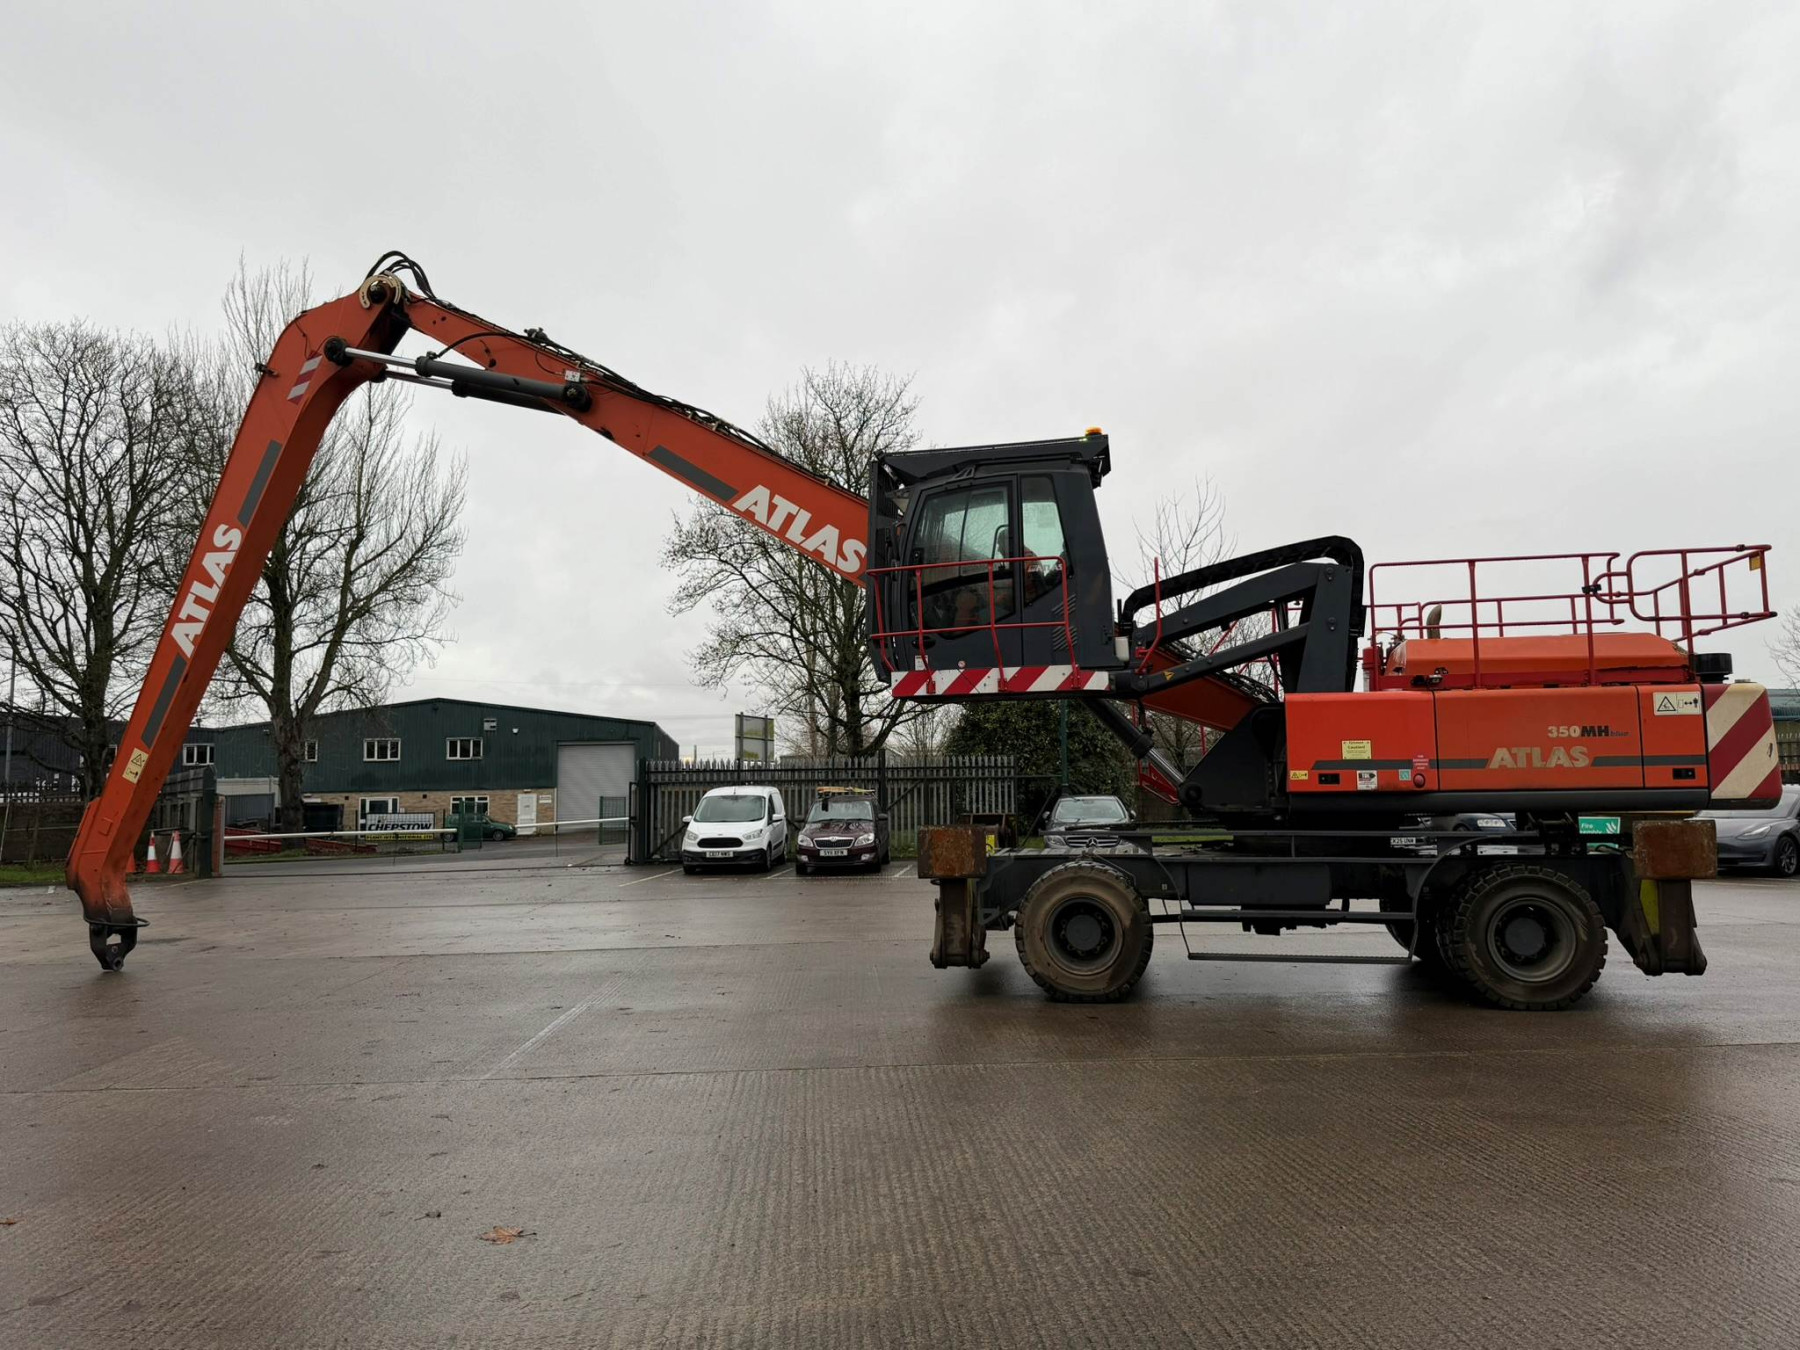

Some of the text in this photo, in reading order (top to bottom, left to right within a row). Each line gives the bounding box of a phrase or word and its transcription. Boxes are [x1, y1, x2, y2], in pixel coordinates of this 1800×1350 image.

[732, 484, 868, 573] ATLAS
[171, 523, 242, 658] ATLAS
[1489, 745, 1590, 769] ATLAS
[368, 822, 432, 832] CHEPSTOW
